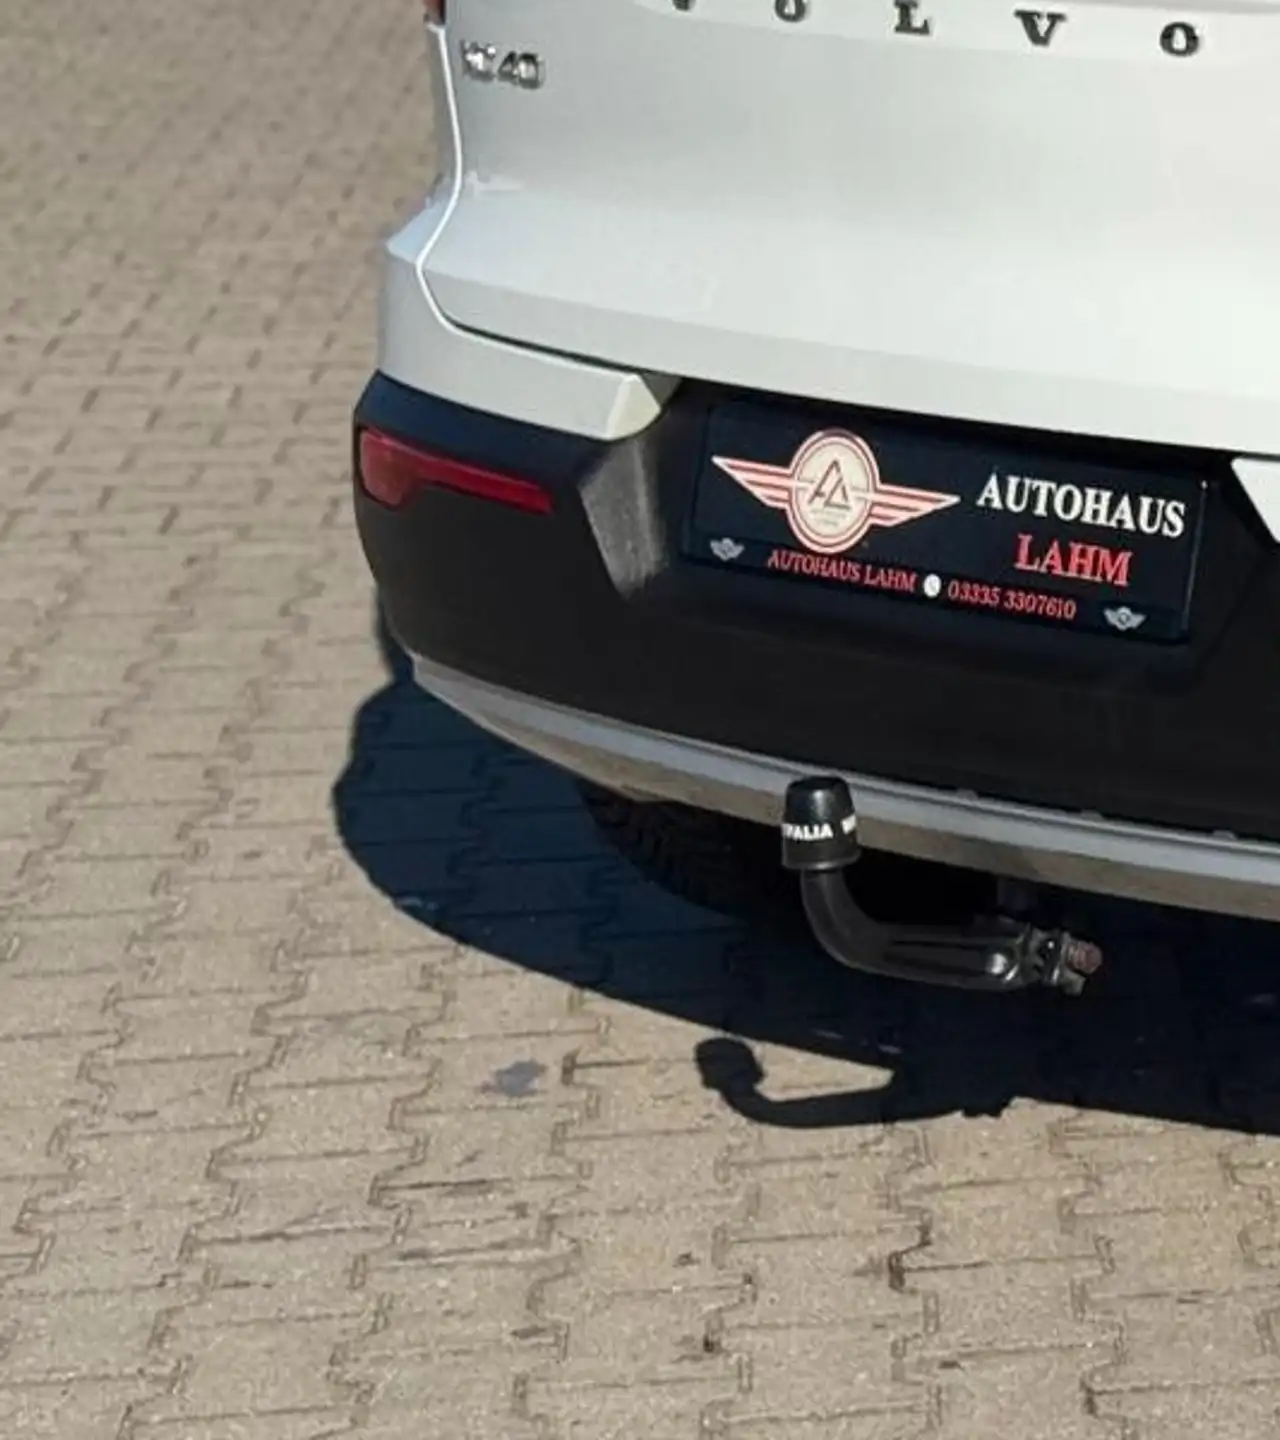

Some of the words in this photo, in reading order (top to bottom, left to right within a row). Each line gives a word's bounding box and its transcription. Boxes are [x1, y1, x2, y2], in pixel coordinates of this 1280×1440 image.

[974, 472, 1186, 539] AUTOHAUS
[765, 548, 861, 583] AUTOHAUS
[863, 566, 917, 594] LAHM
[947, 580, 1000, 608] 03335
[1002, 592, 1077, 621] 3307610
[1013, 533, 1134, 588] LAHM
